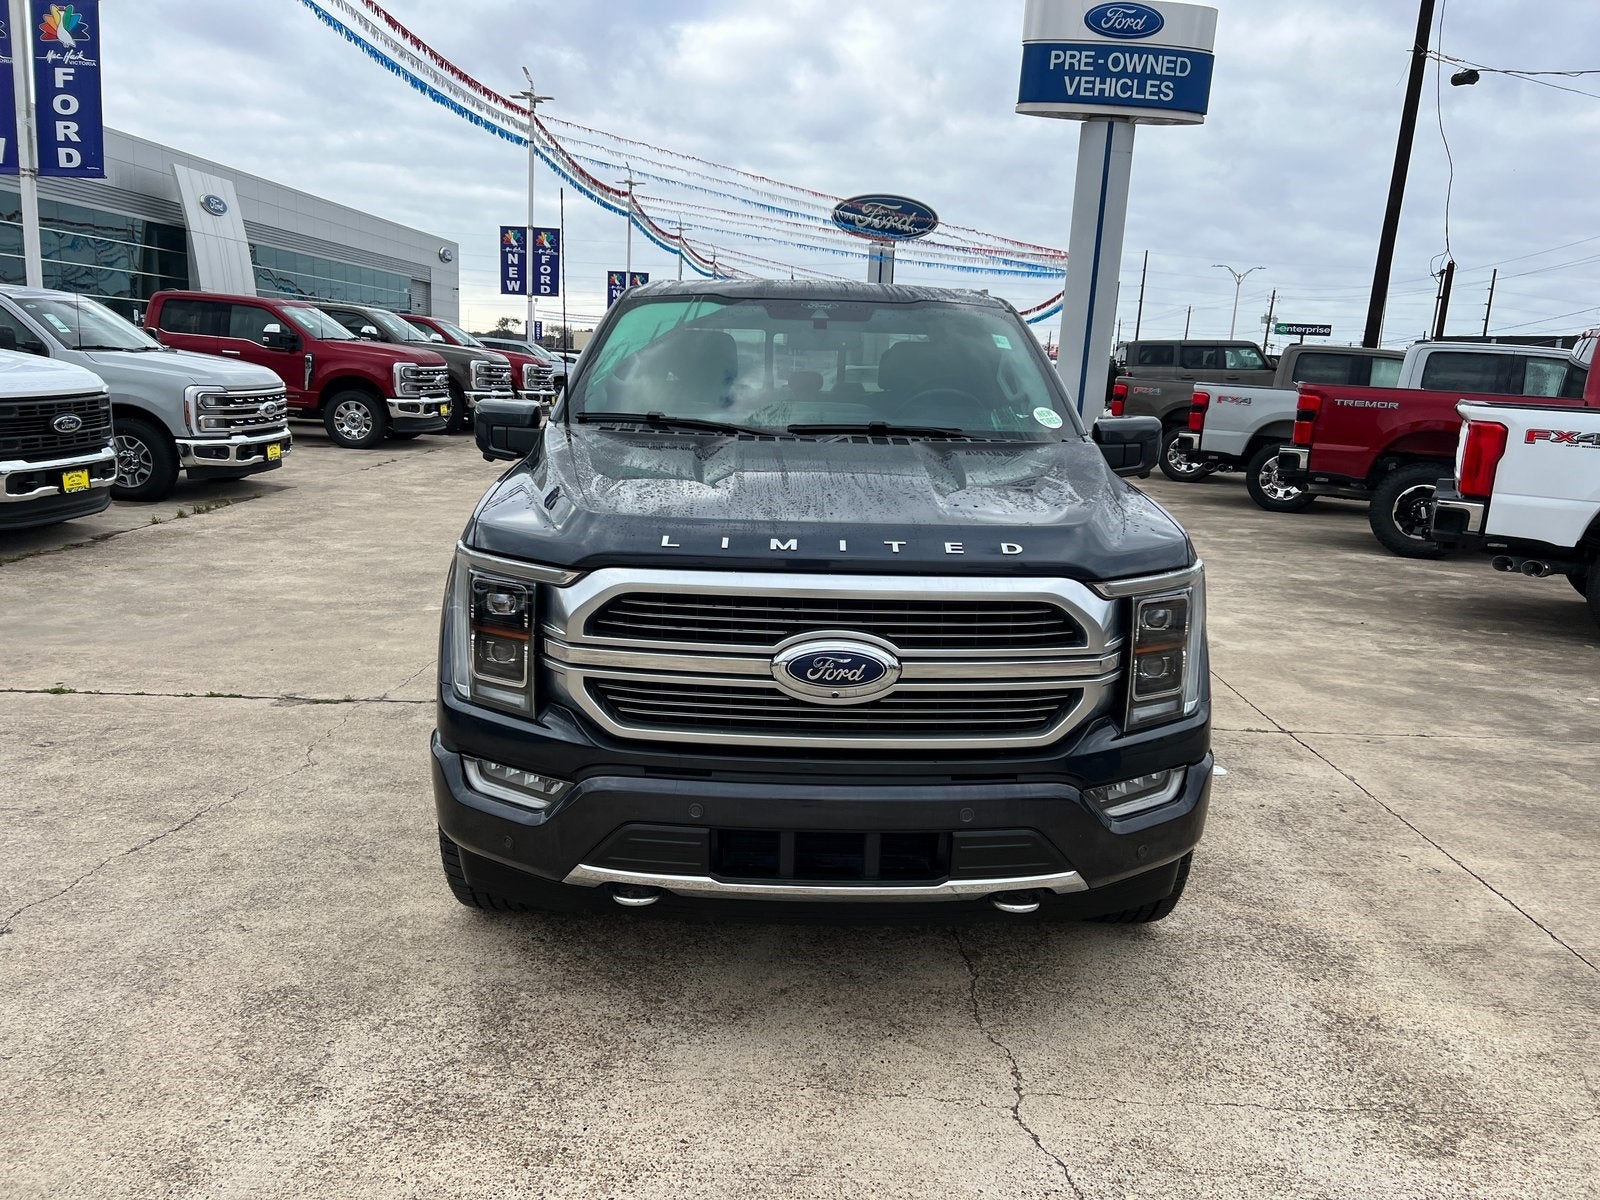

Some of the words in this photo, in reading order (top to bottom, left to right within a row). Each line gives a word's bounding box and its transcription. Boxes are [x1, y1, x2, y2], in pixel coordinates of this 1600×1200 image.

[1100, 7, 1147, 31] Ford
[44, 50, 63, 63] Mac
[63, 49, 86, 64] Haik
[1064, 75, 1175, 101] VEHICLES
[52, 67, 82, 168] FORD
[854, 202, 917, 231] Ford
[506, 252, 520, 291] NEW
[540, 255, 551, 294] FORD
[1278, 325, 1331, 335] enterprise
[1216, 395, 1252, 406] FX4
[1334, 399, 1400, 410] TREMOR
[61, 419, 77, 430] Ford
[1524, 429, 1600, 446] FX4
[661, 535, 1024, 555] LIMITED
[806, 656, 867, 681] Ford
